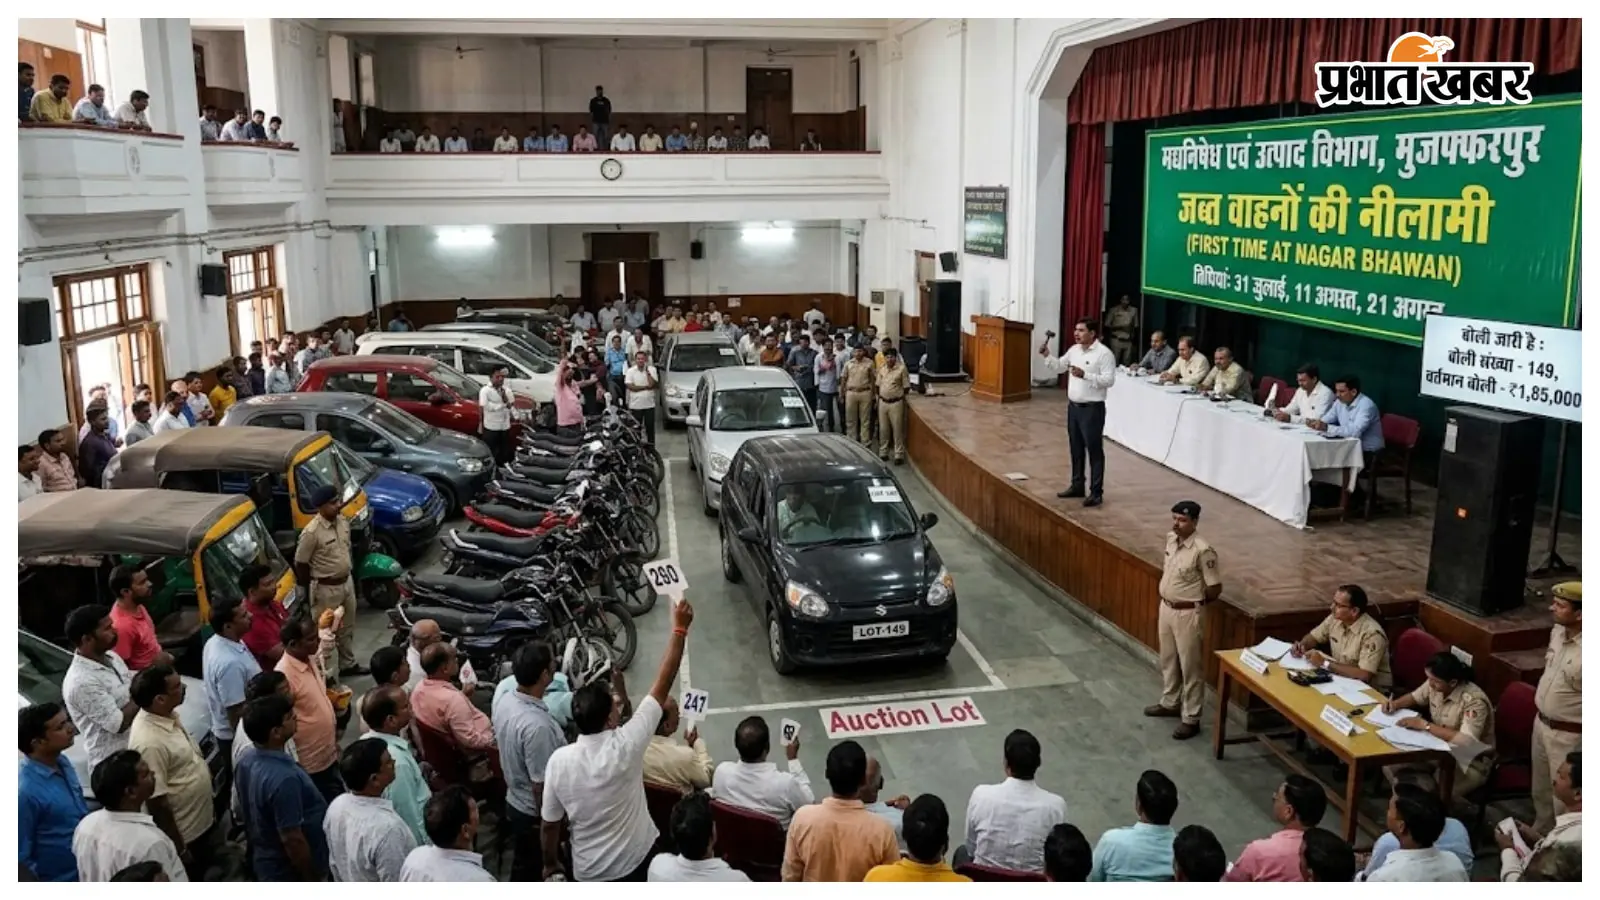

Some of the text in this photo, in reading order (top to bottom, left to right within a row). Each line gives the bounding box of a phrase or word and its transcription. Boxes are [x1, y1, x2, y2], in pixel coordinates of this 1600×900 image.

[1226, 133, 1252, 169] एवं
[1255, 139, 1308, 169] उत्पाद
[1312, 129, 1386, 173] विभाग,
[1395, 125, 1545, 179] मुजफ्फरपुर
[1228, 183, 1305, 232] वाहनों
[1308, 184, 1352, 235] की
[1359, 184, 1496, 244] नीलामी
[1187, 233, 1461, 287] (FIRST TIME AT NAGAR BHAWAN)
[1234, 274, 1249, 293] 31
[1295, 283, 1311, 304] 11
[1367, 293, 1387, 316] 21
[1461, 325, 1492, 346] बोली
[1494, 331, 1522, 350] जारी
[1525, 331, 1536, 351] है
[1448, 347, 1476, 367] बोली
[1528, 361, 1559, 382] 149,
[1426, 367, 1464, 389] वर्तमान
[1467, 373, 1497, 395] बोली
[1509, 382, 1582, 408] ₹1,85,000
[650, 564, 680, 587] 290
[860, 623, 906, 637] LOT-149
[684, 693, 706, 713] 247
[830, 700, 979, 733] Auction Lot
